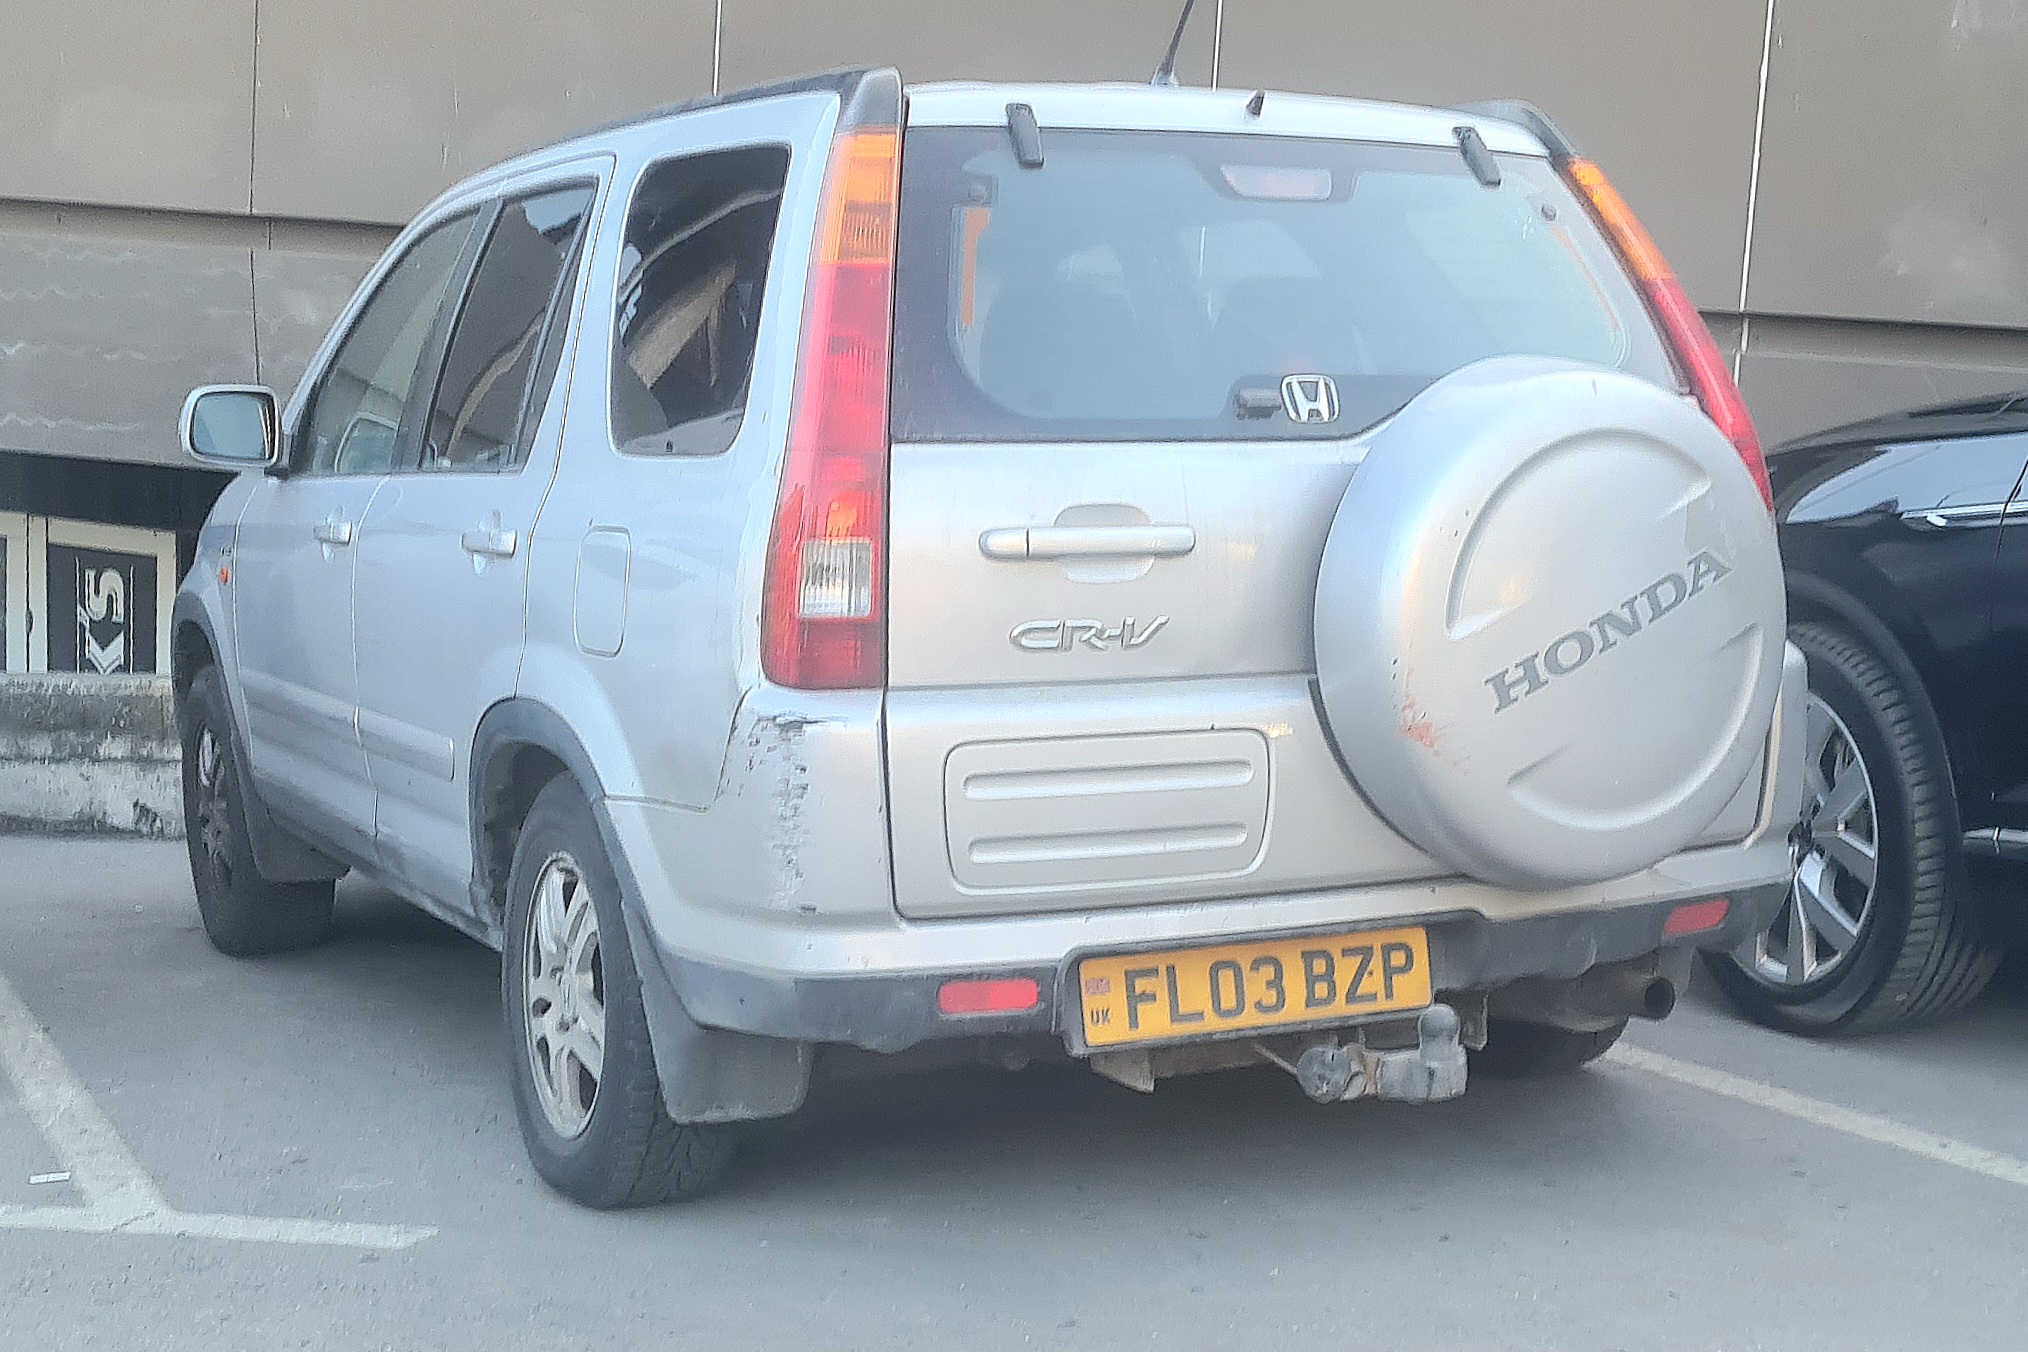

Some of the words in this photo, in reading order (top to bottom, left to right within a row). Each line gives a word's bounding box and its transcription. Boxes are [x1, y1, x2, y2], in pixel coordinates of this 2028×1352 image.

[1009, 614, 1171, 651] CR-V
[1484, 550, 1734, 714] HONDA
[1089, 1007, 1111, 1026] UK
[1123, 954, 1287, 1032] FL03
[1300, 942, 1415, 1009] BZP
